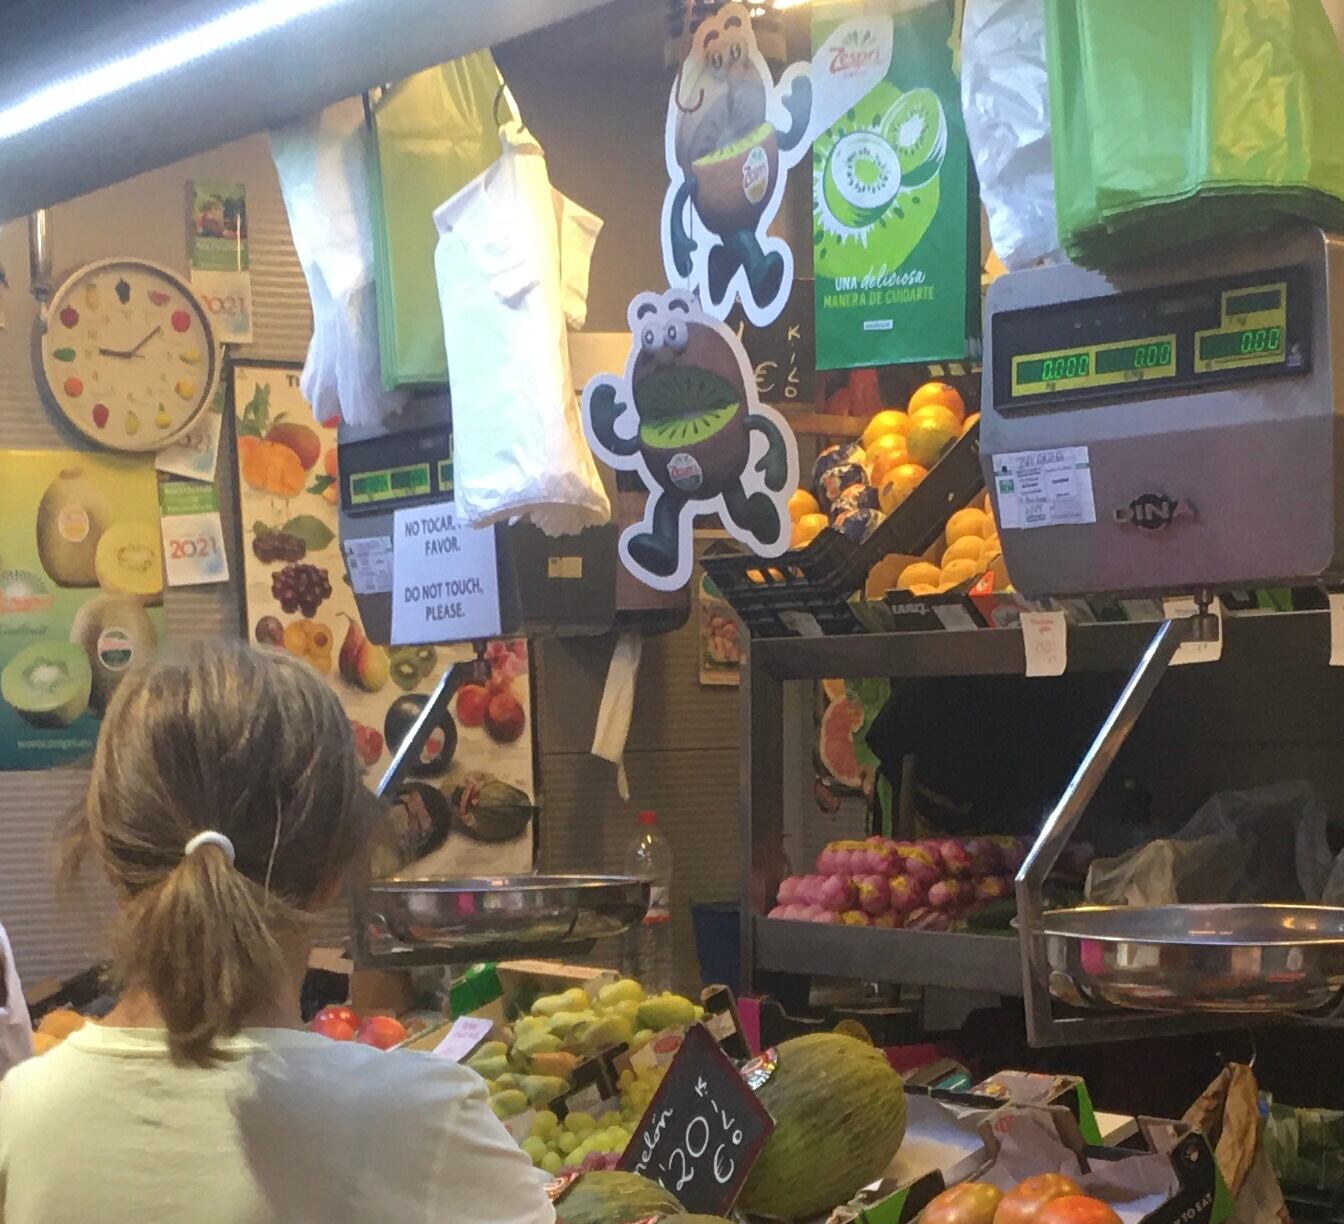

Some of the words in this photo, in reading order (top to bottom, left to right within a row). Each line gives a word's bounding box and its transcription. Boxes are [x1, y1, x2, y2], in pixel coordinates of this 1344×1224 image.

[829, 48, 880, 74] Zespri
[835, 275, 858, 291] UNA
[860, 263, 927, 290] deliciosa
[823, 292, 866, 308] MANERA
[869, 290, 883, 306] DE
[886, 285, 934, 305] CUIDARTE
[404, 520, 420, 537] NO
[170, 537, 219, 557] 2021
[424, 539, 461, 556] FAVOR.
[404, 586, 420, 603] DO
[422, 582, 444, 602] NOT
[446, 577, 484, 597] TOUCH,
[424, 603, 466, 621] PLEASE.
[1181, 1207, 1196, 1223] TO
